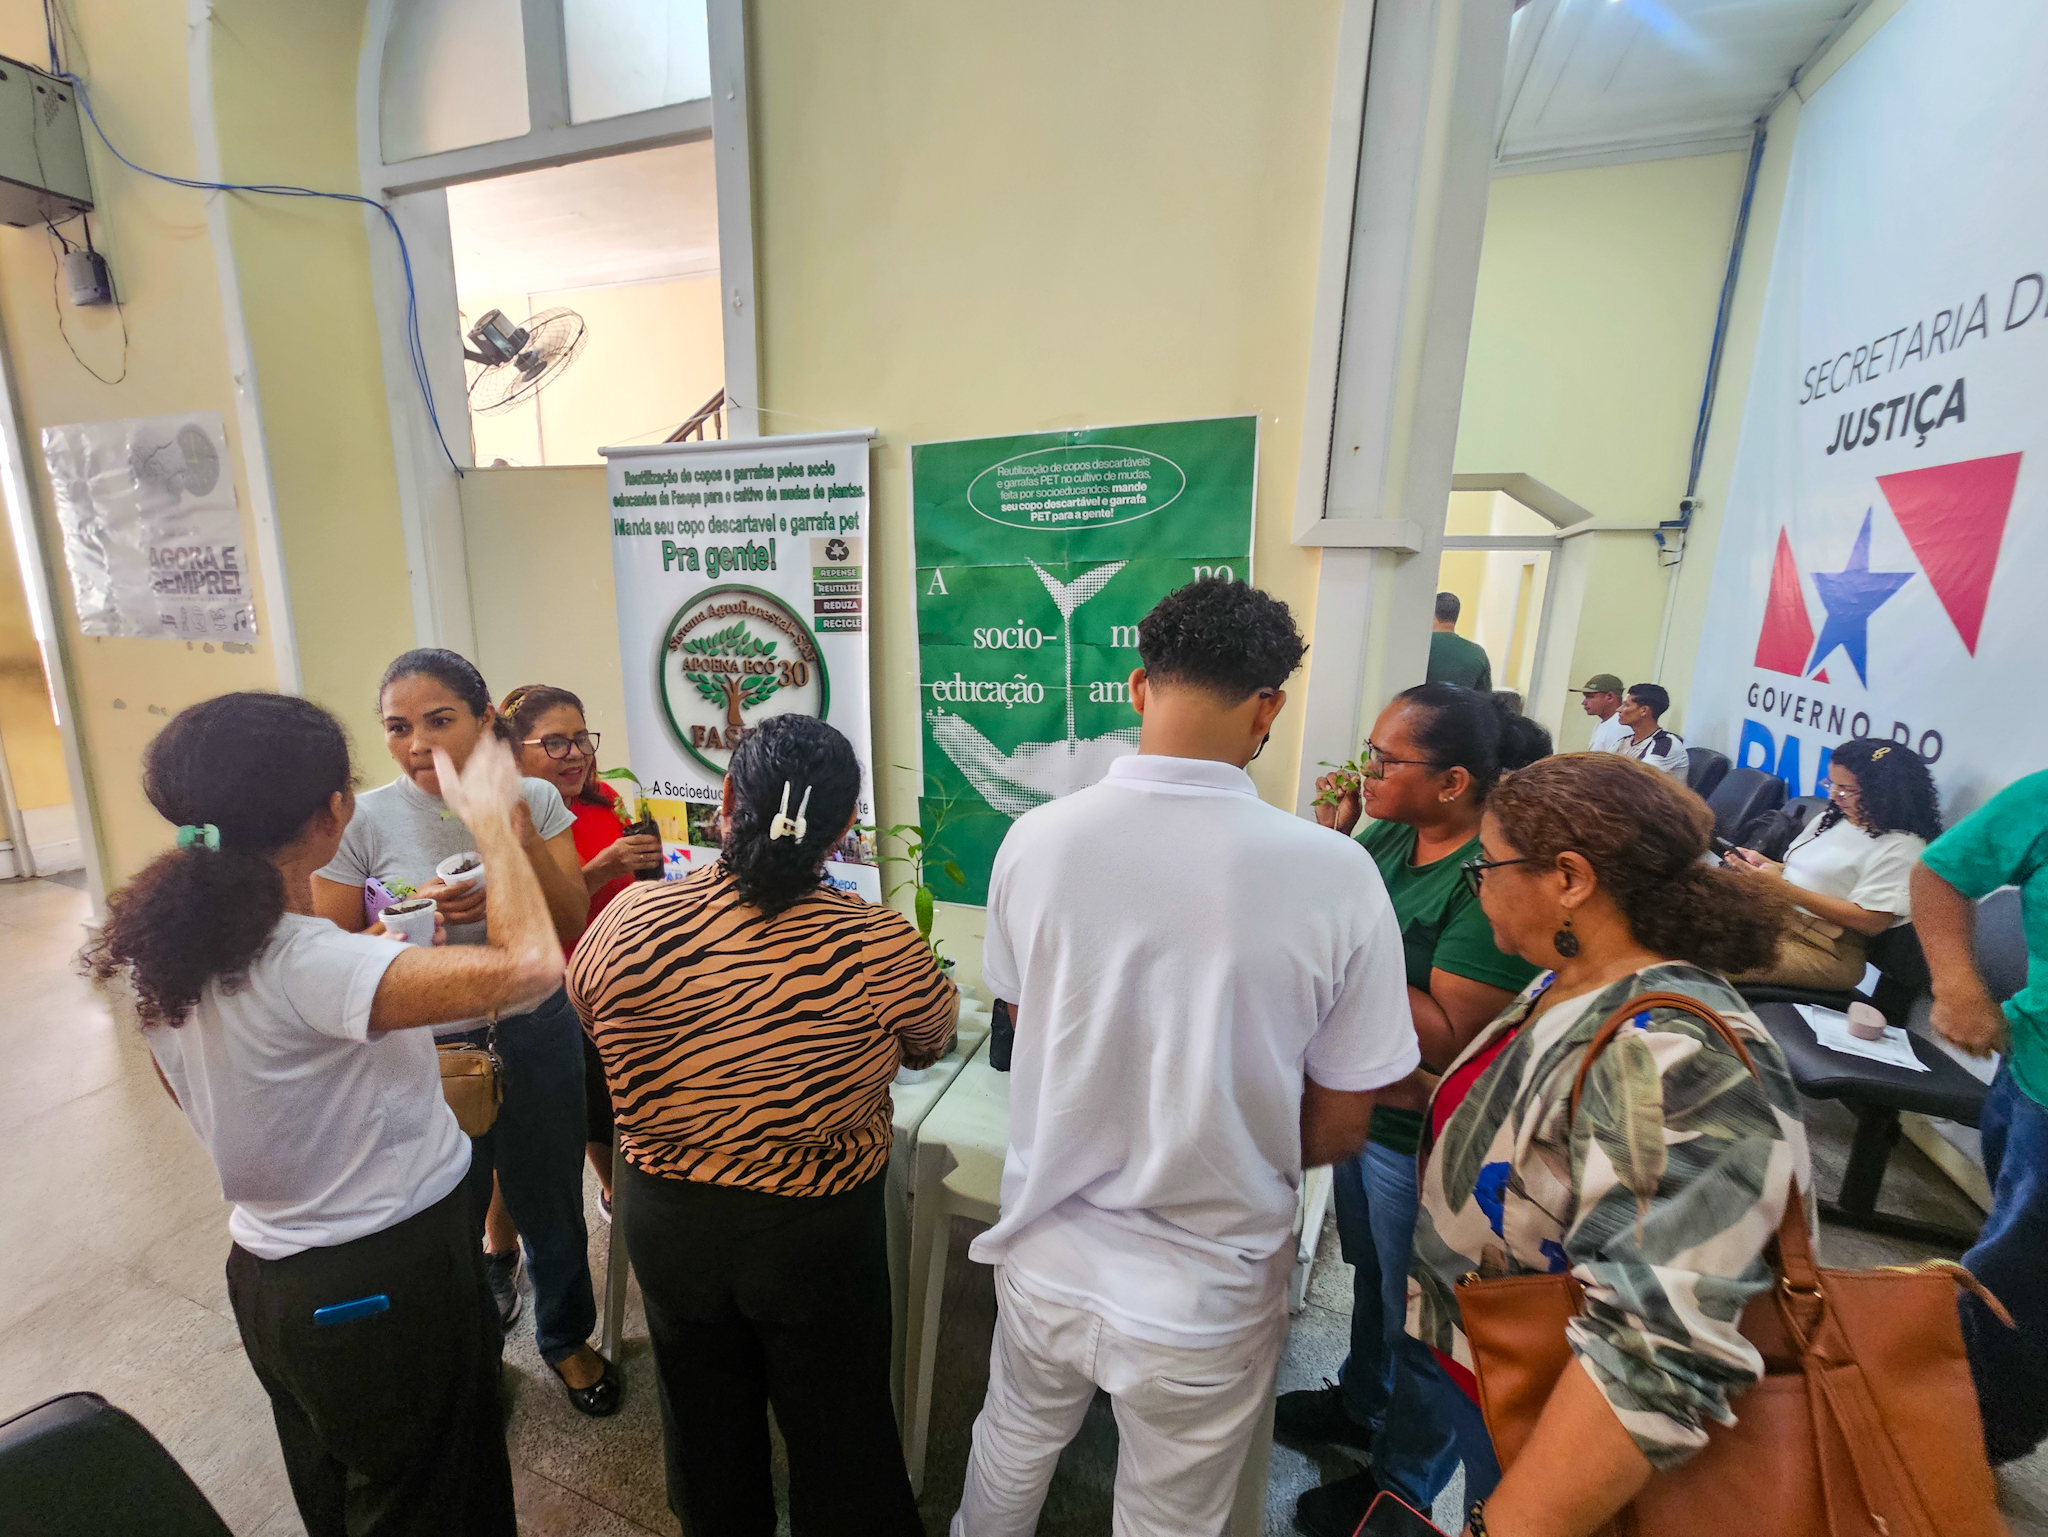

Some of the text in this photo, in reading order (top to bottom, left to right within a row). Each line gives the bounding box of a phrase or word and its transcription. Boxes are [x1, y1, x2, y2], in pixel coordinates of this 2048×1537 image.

[1799, 271, 2048, 406] SECRETARIA D
[1825, 376, 1967, 456] JUSTIÇA
[680, 468, 692, 483] de
[694, 469, 722, 485] copos
[725, 468, 731, 481] e
[733, 463, 774, 484] garrafas
[777, 461, 804, 482] pelos
[807, 460, 835, 477] socio
[996, 468, 1151, 490] e garrafas PET no cultivo de mudas,
[997, 456, 1151, 477] Reutilização de copos descartáveis
[659, 490, 670, 505] da
[671, 490, 702, 508] Fasepa
[703, 491, 724, 508] para
[725, 491, 732, 503] o
[733, 486, 764, 503] cultivo
[766, 485, 778, 501] de
[779, 484, 811, 501] mudas
[813, 483, 825, 499] de
[1000, 481, 1148, 501] feita por socioeducandos: mande
[1000, 493, 1147, 512] seu copo descartável e garrafa
[653, 520, 675, 535] seu
[677, 518, 706, 539] copo
[708, 513, 776, 535] descartavel
[779, 517, 788, 532] e
[790, 511, 836, 537] garrafa
[839, 510, 860, 535] pet
[1030, 507, 1115, 523] PET para a gente!
[149, 546, 239, 571] AGORA E
[662, 538, 778, 579] Pra gente!
[820, 568, 858, 578] REPENSE
[926, 568, 949, 596] A
[818, 584, 861, 594] REUTILIZE
[823, 601, 859, 610] REDUZA
[668, 610, 708, 652] Sistema
[822, 618, 862, 629] RECICLE
[973, 619, 1058, 650] socio-
[682, 656, 741, 674] APOENA
[776, 658, 810, 688] 30
[932, 672, 1045, 710] educação
[1747, 682, 1944, 765] GOVERNO DO
[690, 724, 747, 751] FAS
[652, 780, 662, 796] A
[664, 781, 725, 801] Socioeduc
